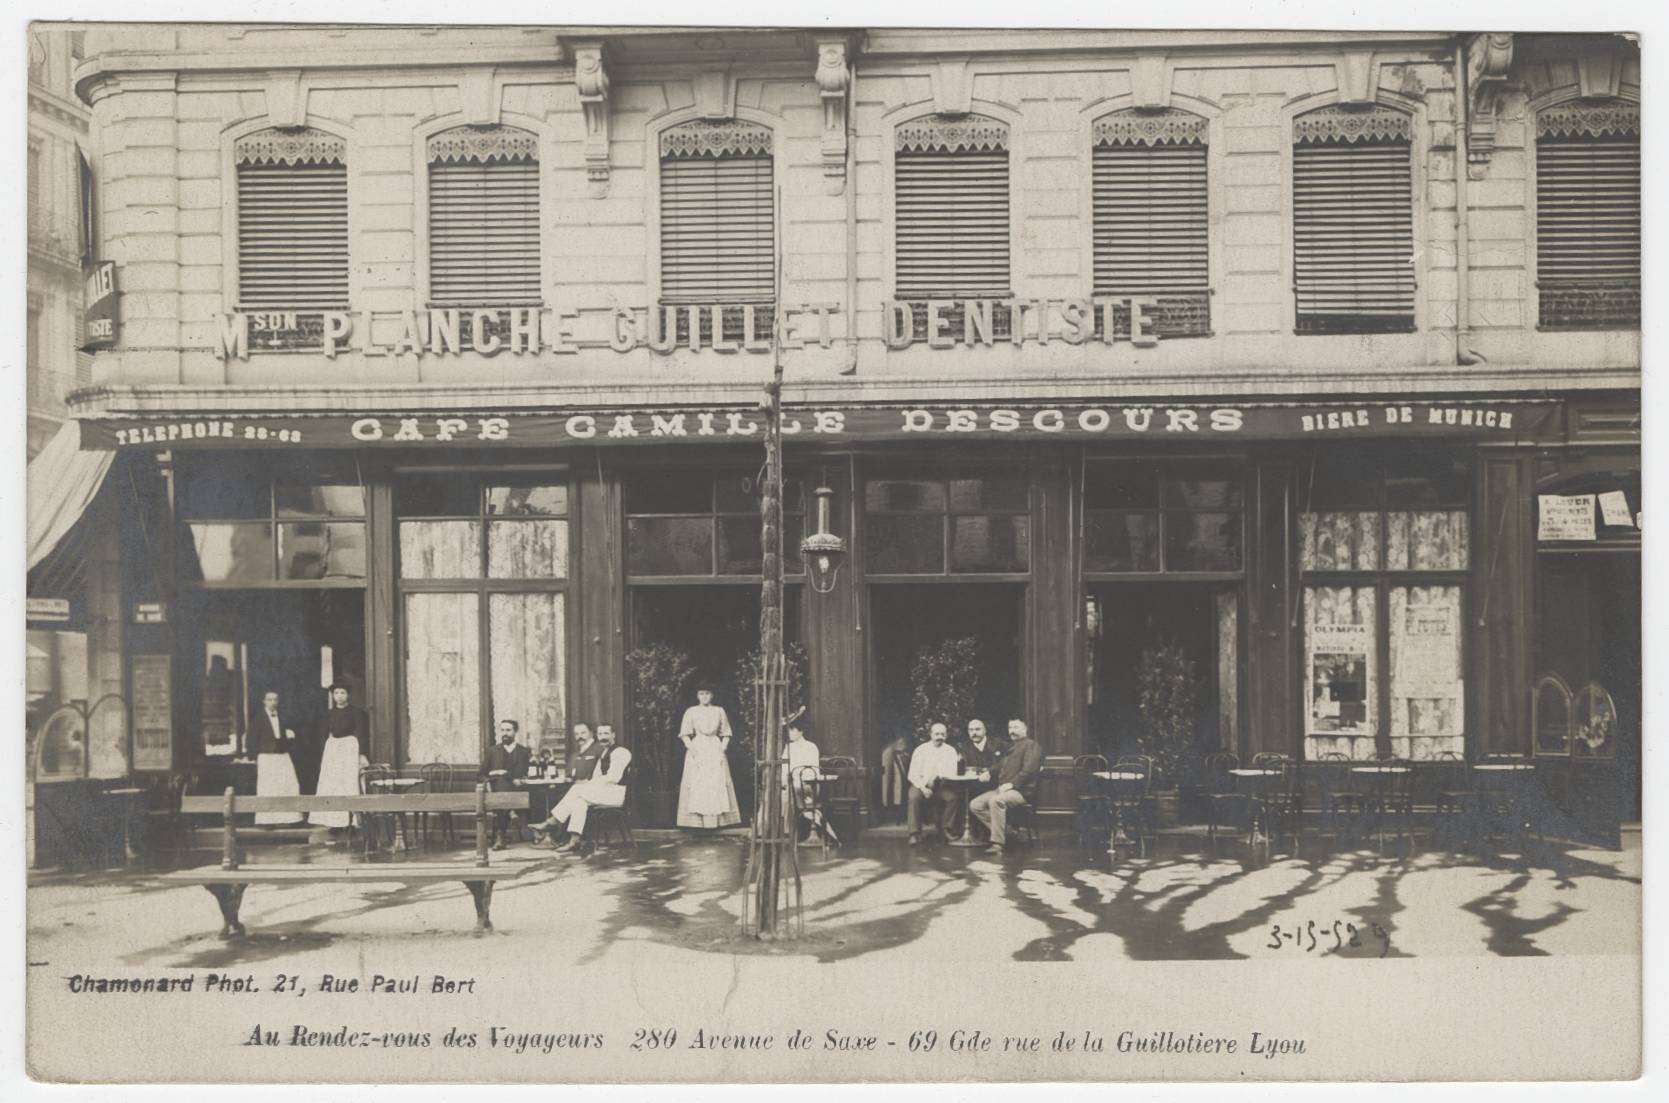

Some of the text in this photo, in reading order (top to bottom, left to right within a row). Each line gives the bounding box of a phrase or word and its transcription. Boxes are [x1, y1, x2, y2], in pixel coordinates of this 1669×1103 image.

[322, 305, 582, 359] PLANCHE
[607, 301, 840, 356] GUILLET
[881, 296, 1161, 351] DENTISTE
[116, 421, 234, 446] TELEPHONE
[351, 417, 511, 442] CAFE
[564, 411, 847, 439] CAMILLE
[900, 408, 1245, 433] DESCOURS
[1301, 409, 1370, 433] BIERE
[1385, 406, 1413, 424] DE
[1428, 408, 1514, 430] MUNICH
[1314, 625, 1366, 634] OLYMPIA
